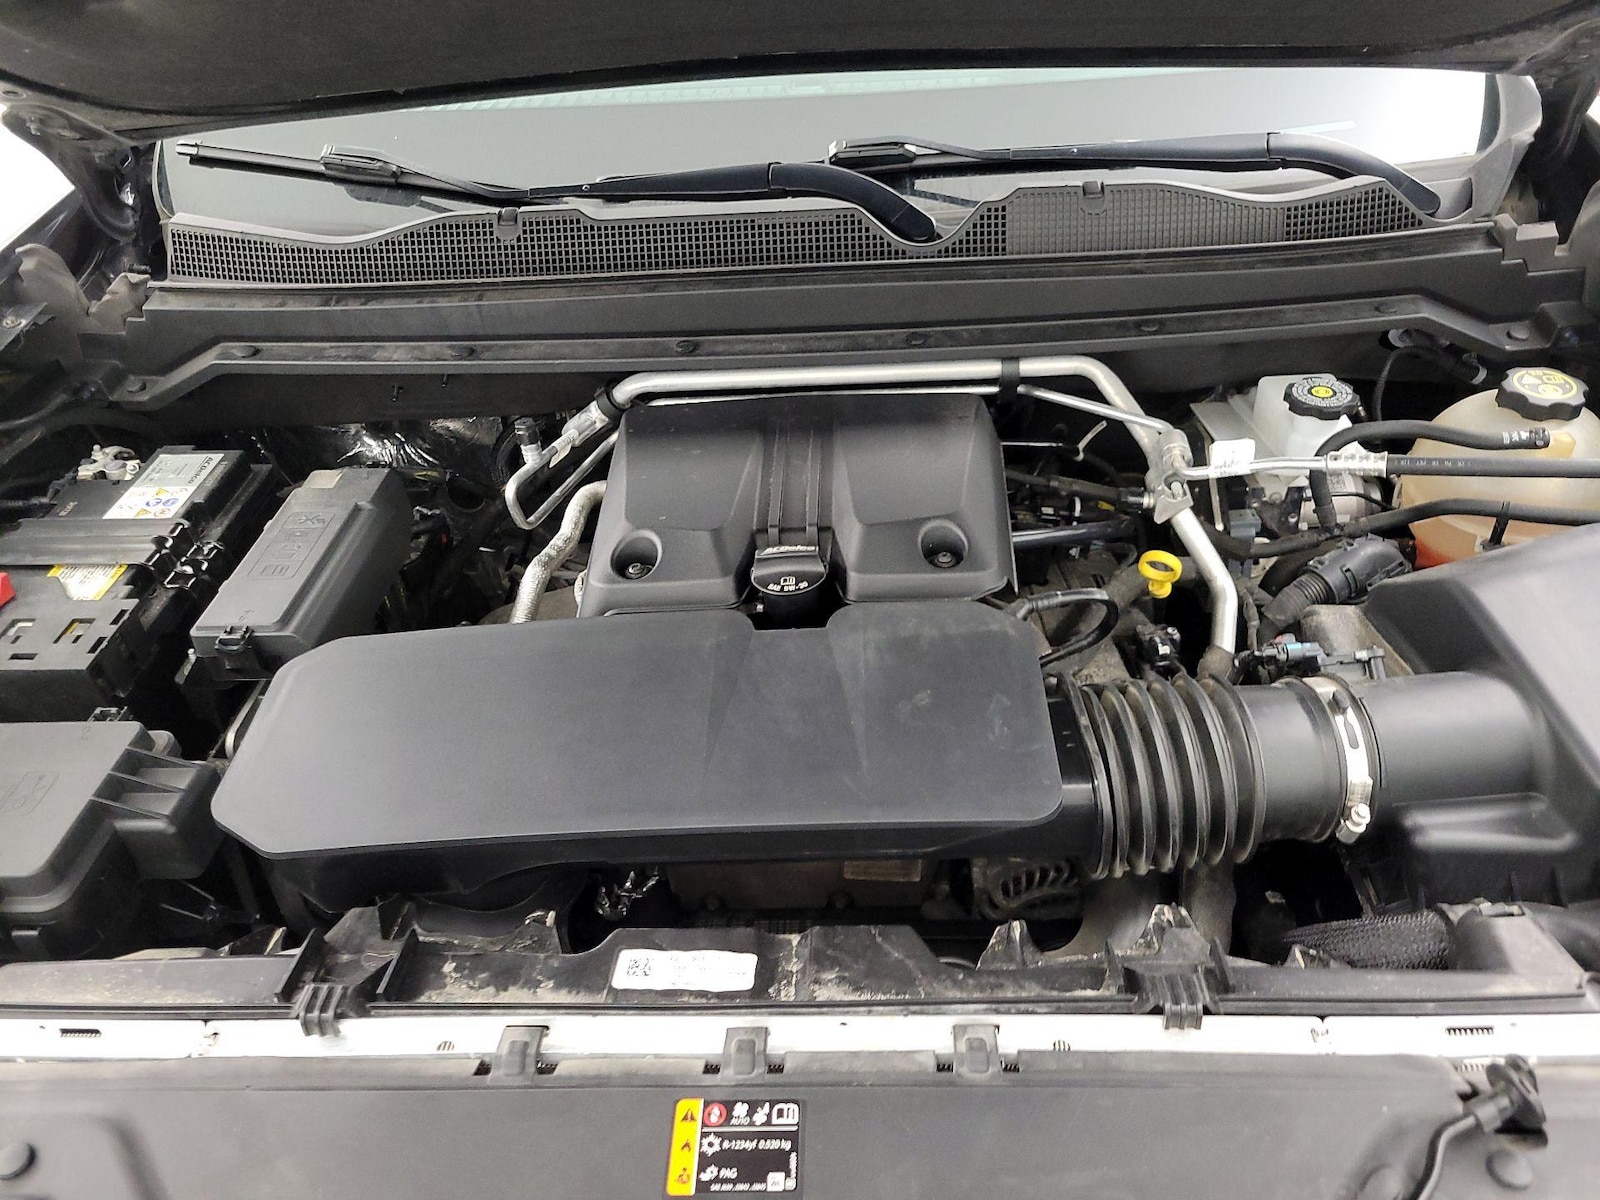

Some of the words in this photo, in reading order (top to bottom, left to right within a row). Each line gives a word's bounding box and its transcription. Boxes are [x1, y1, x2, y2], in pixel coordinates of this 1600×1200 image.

[188, 456, 213, 484] ACDelco
[731, 1116, 750, 1125] AUTO
[780, 1138, 791, 1151] kg
[720, 1168, 738, 1178] PAG
